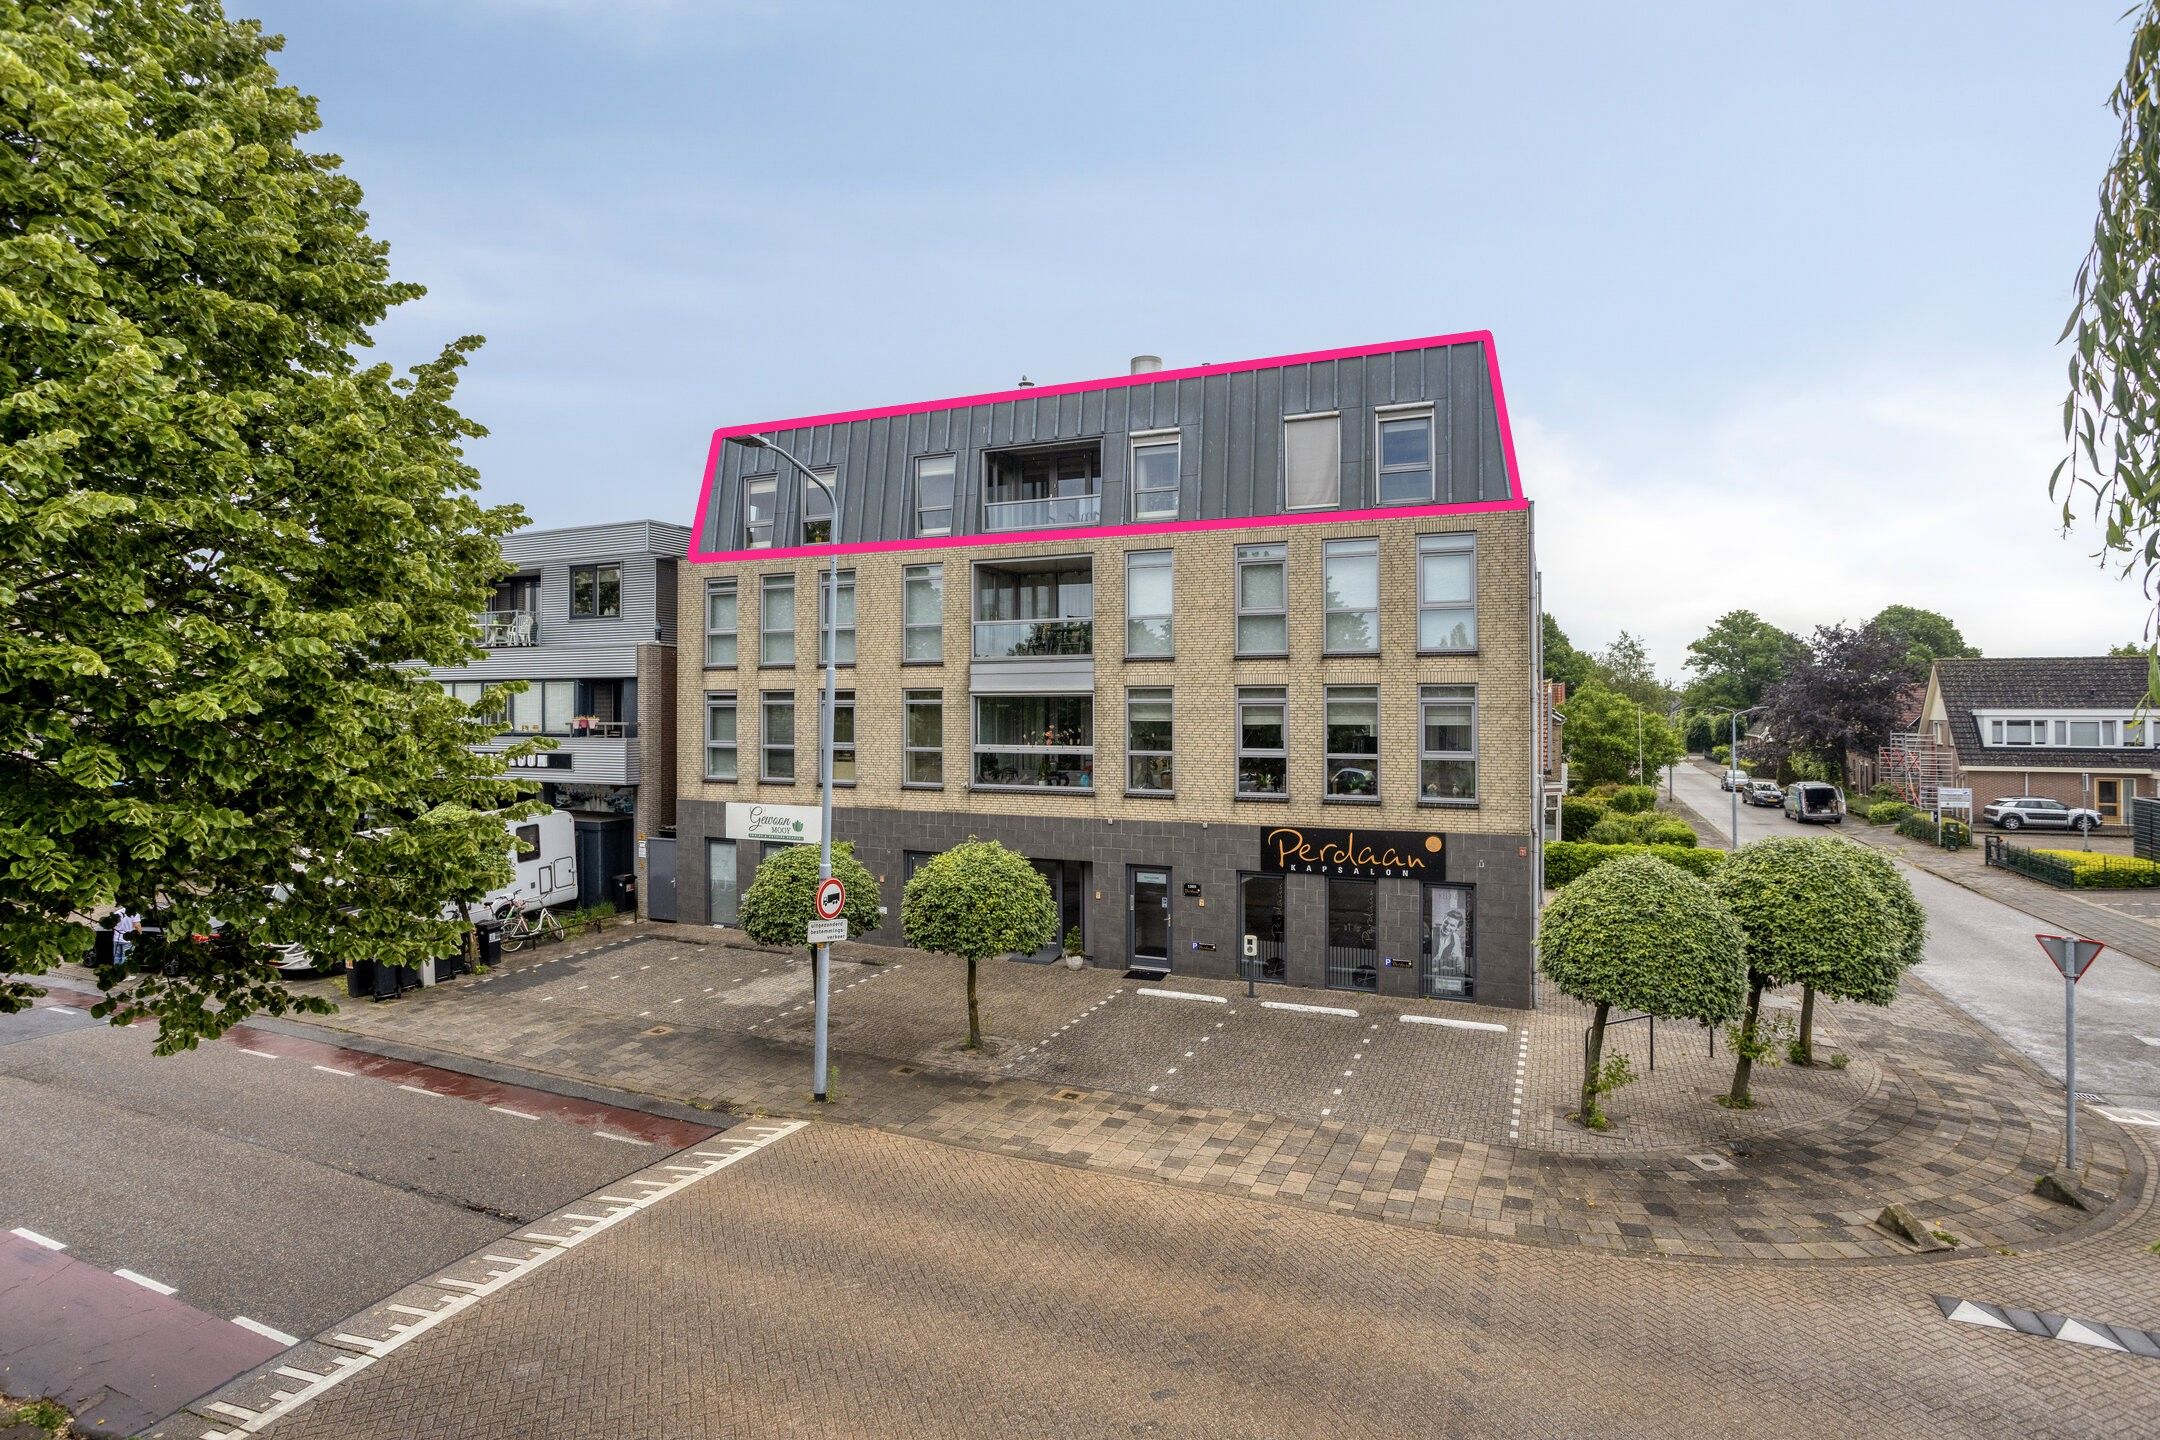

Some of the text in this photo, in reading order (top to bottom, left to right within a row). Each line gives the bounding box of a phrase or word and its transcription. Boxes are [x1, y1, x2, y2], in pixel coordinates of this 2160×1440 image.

[748, 806, 791, 831] Gewoon
[771, 826, 791, 834] MOOY
[1268, 828, 1426, 868] Perdaan
[1290, 864, 1409, 877] KAPSALON
[1385, 958, 1391, 966] P
